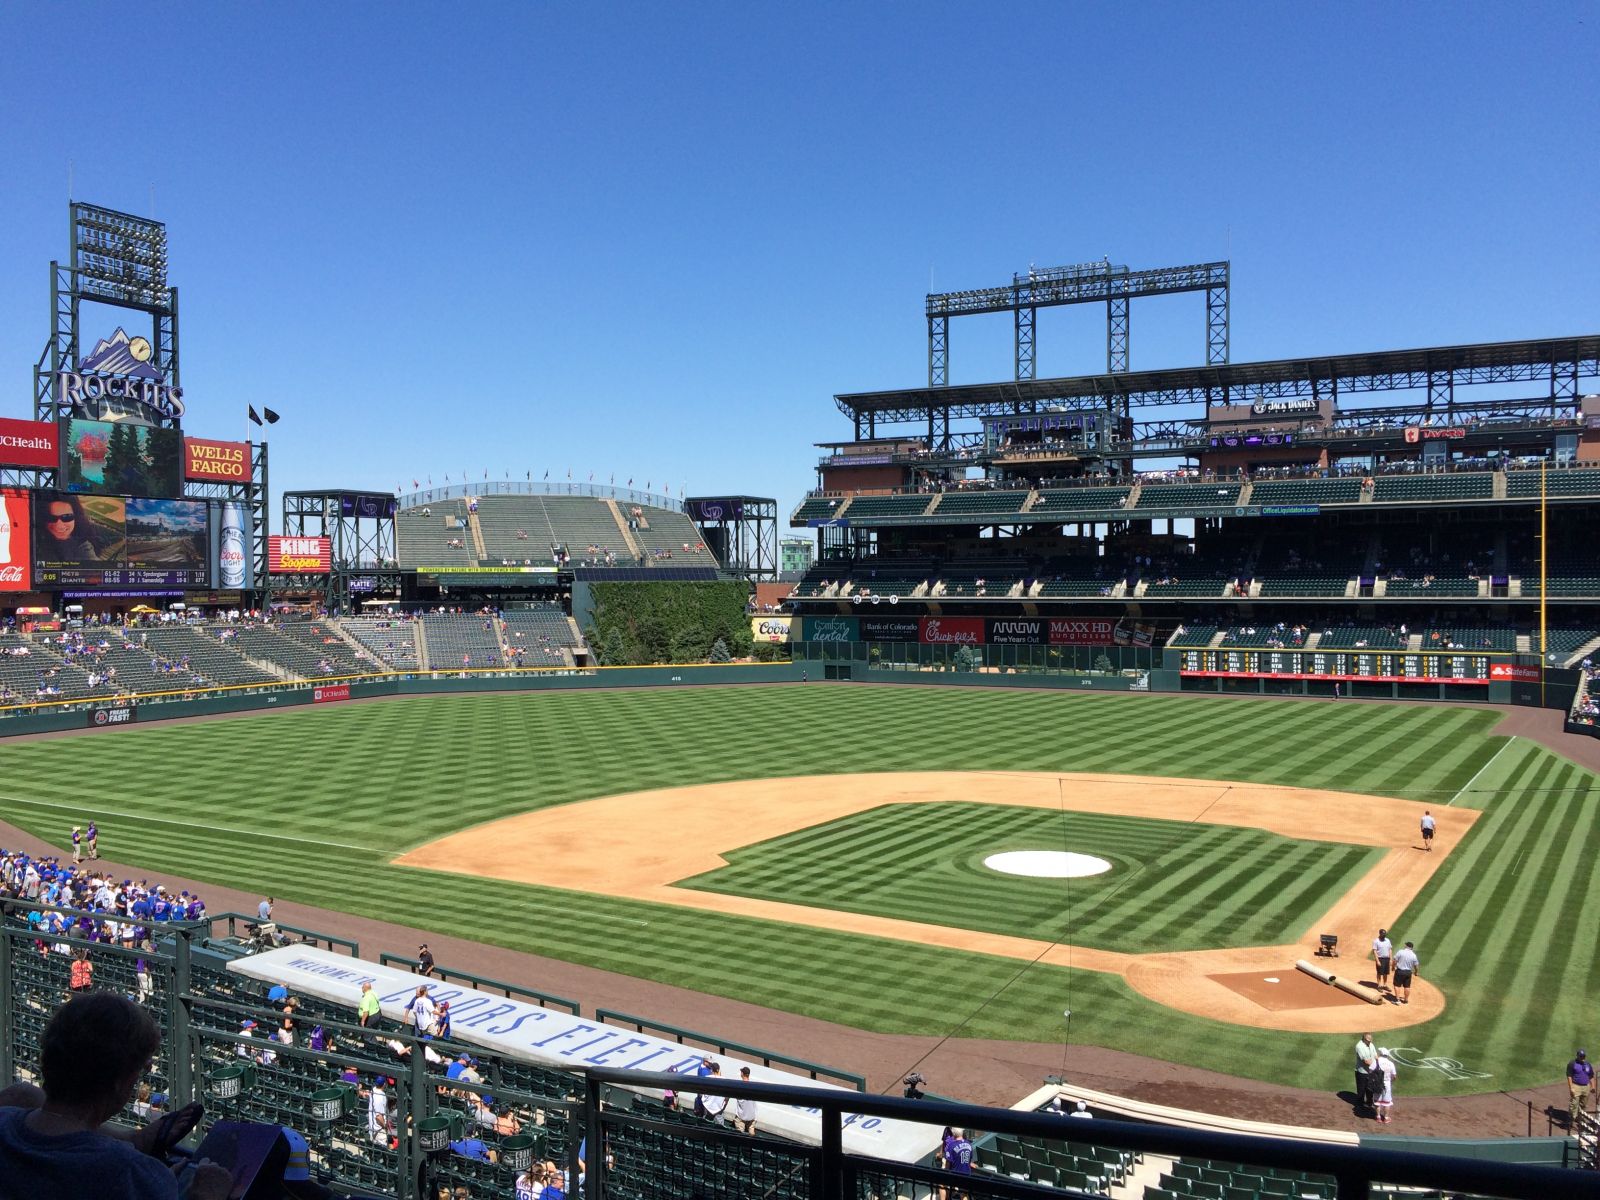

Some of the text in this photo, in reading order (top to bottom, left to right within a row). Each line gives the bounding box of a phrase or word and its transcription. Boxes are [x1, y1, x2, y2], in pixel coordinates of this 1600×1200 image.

[57, 371, 186, 419] ROCKIES
[1268, 401, 1287, 410] JACK
[1421, 430, 1465, 439] TAVERN
[190, 445, 243, 462] WELLS
[191, 460, 243, 476] FARGO
[280, 540, 320, 555] KING
[280, 554, 321, 571] Soopers
[759, 622, 790, 635] Coors
[815, 619, 845, 631] Comfort
[889, 623, 917, 631] Colorado
[993, 622, 1040, 634] ARROW
[1050, 622, 1112, 633] MAXX HD
[813, 628, 848, 641] dental
[109, 714, 130, 722] FAST!
[287, 958, 377, 986] WELCOME TO
[416, 1001, 425, 1015] 44
[531, 1024, 705, 1074] FIELD
[844, 1112, 882, 1132] CO.
